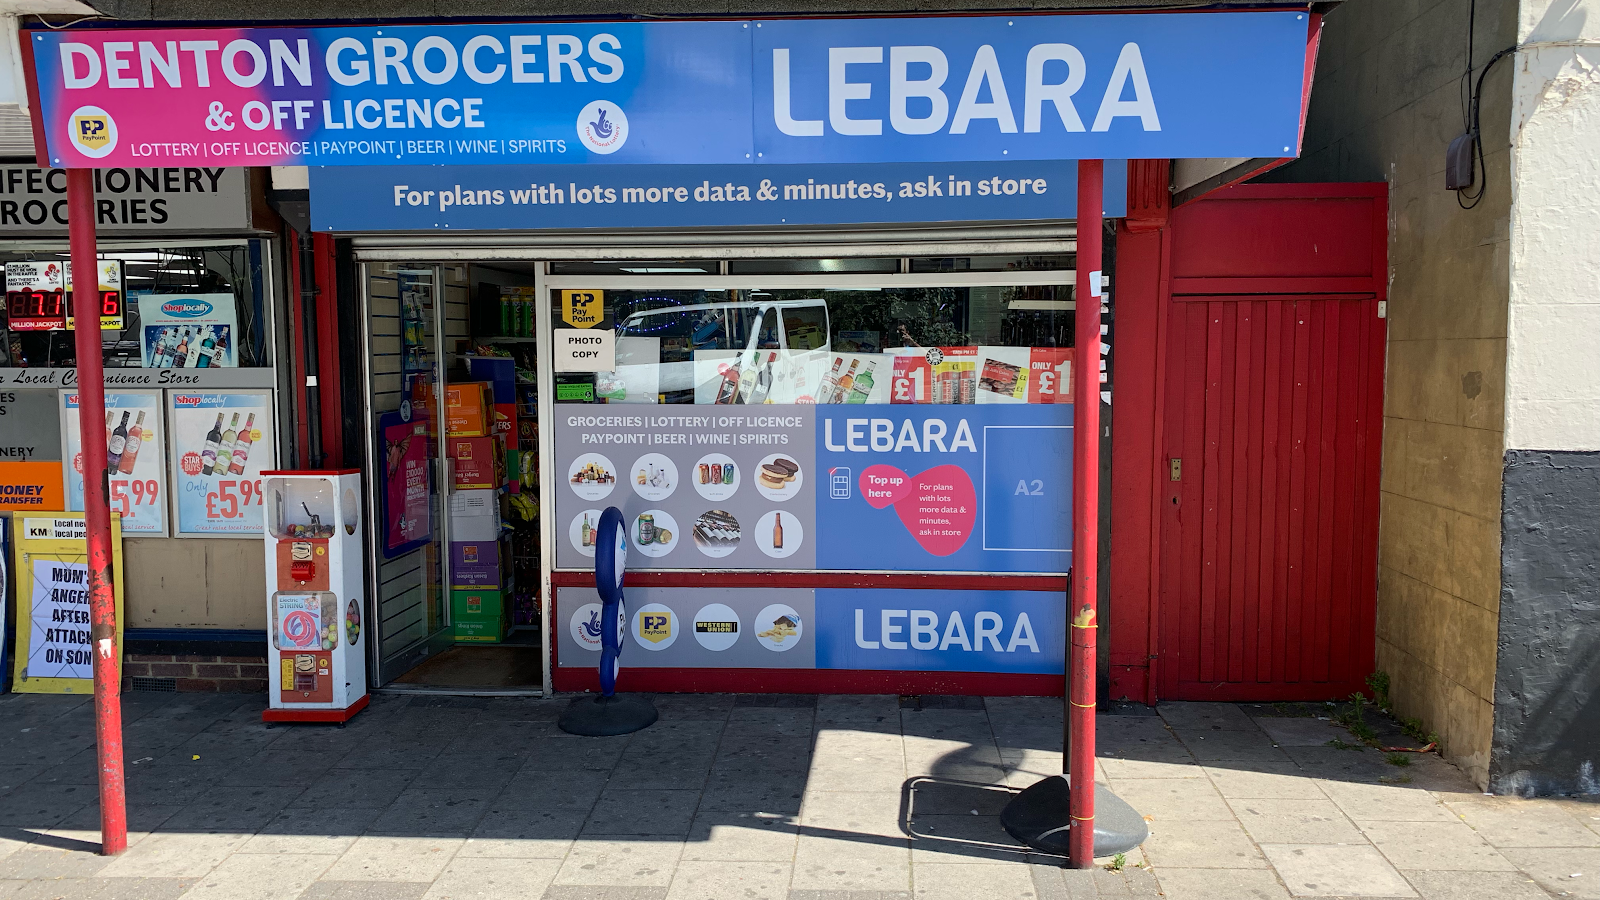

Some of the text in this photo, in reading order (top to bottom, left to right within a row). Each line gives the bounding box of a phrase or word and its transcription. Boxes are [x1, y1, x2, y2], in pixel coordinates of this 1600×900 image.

[59, 33, 625, 90] DENTON GROCERS
[772, 41, 1162, 137] LEBARA
[205, 97, 486, 131] & OFF LICENCE
[589, 135, 612, 147] National
[609, 124, 621, 145] Lottery
[131, 138, 567, 157] LOTTERY OFF LICENCE PAYPOINT BEER WINE SPIRITS
[0, 168, 225, 194] FECIONERY
[393, 174, 1048, 212] For plans with lots more data & minutes, ask in store
[0, 199, 170, 225] ROCRIES
[571, 307, 588, 318] Pay
[571, 314, 596, 323] Point
[568, 336, 602, 345] PHOTO
[571, 350, 599, 359] COPY
[1032, 361, 1051, 370] ONLY
[12, 369, 55, 384] Local
[158, 369, 200, 384] Store
[893, 369, 906, 377] NLY
[1038, 360, 1072, 395] £1
[894, 366, 925, 401] £1
[567, 416, 803, 428] GROCERIES LOTTERY OFF LICENCE
[581, 433, 789, 445] PAYPOINT BEER WINE SPIRITS
[824, 418, 978, 453] LEBARA
[184, 456, 200, 464] STAR
[184, 463, 201, 472] BUYS
[868, 475, 903, 486] Top up
[185, 479, 209, 498] Only
[868, 488, 892, 498] here
[919, 482, 953, 493] For plans
[1014, 479, 1044, 496] A2
[110, 479, 159, 518] 5.99
[919, 494, 951, 502] with lots
[940, 505, 958, 514] data
[959, 506, 966, 514] &
[54, 519, 73, 528] Local
[919, 517, 951, 525] minutes,
[54, 530, 73, 538] local
[194, 524, 212, 532] Great
[919, 528, 932, 536] ask
[933, 528, 940, 536] in
[52, 608, 90, 624] AFTER
[854, 608, 1041, 653] LEBARA
[45, 648, 92, 665] ON SON
